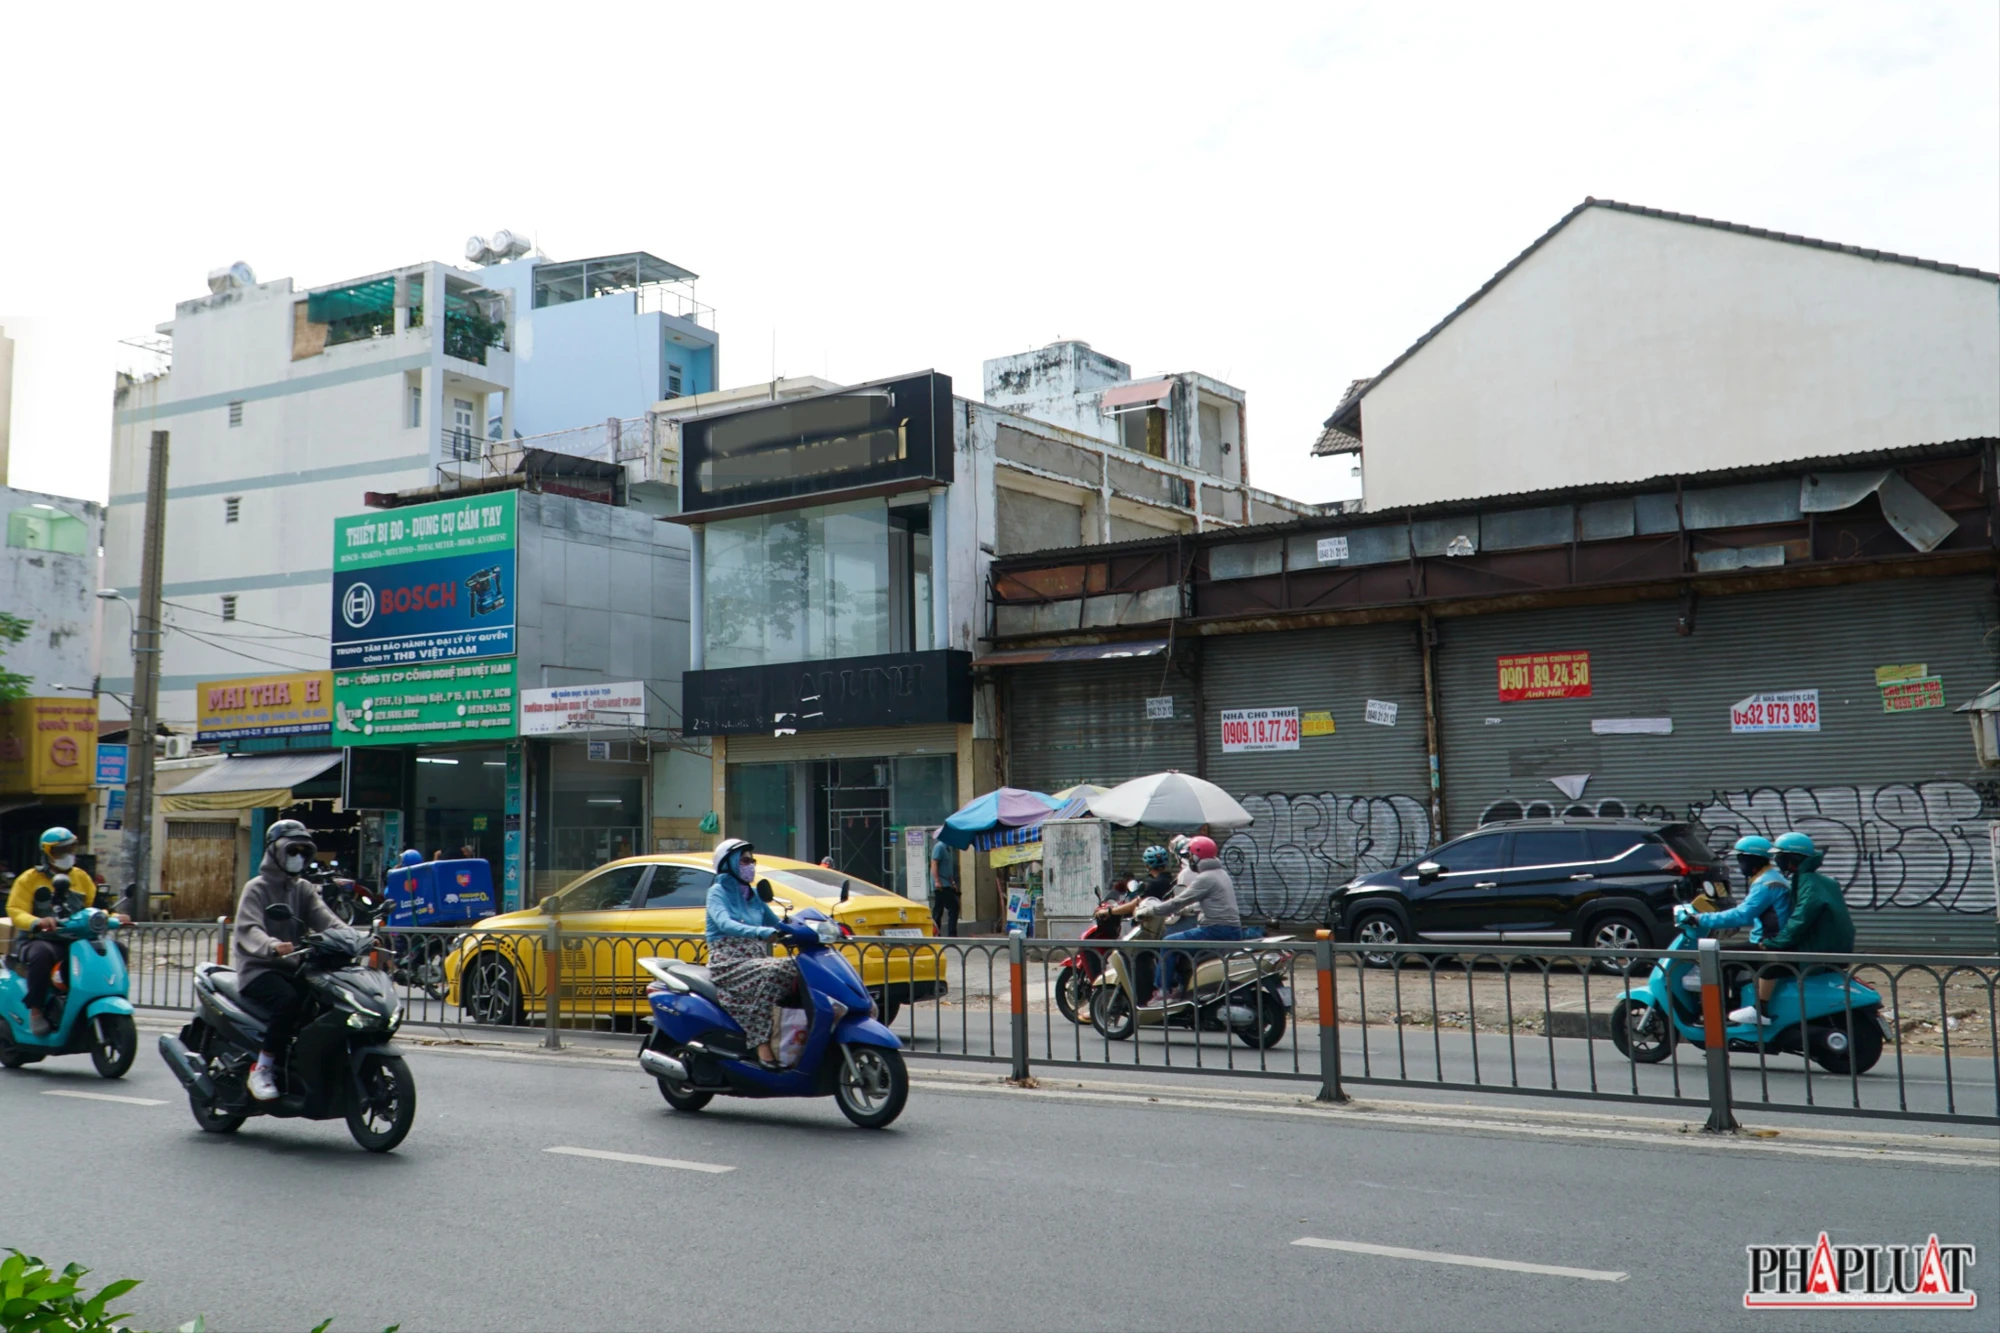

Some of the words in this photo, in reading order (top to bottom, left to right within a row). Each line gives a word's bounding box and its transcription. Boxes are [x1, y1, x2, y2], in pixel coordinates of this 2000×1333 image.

[346, 519, 376, 546] THIẾT
[378, 522, 389, 545] BỊ
[412, 514, 439, 540] DỤNG
[442, 512, 456, 536] CỤ
[482, 506, 502, 527] TAY
[380, 582, 456, 615] BOSCH
[336, 646, 362, 656] TRUNG
[364, 643, 382, 654] TÂM
[402, 638, 426, 649] HÀNH
[436, 636, 452, 646] ĐẠI
[363, 654, 382, 663] CÔNG
[393, 652, 416, 662] THB
[420, 647, 444, 660] VIỆT
[448, 645, 478, 656] NAM
[355, 672, 380, 685] CÔNG
[382, 673, 392, 683] TY
[392, 672, 404, 682] CP
[406, 668, 432, 681] CÔNG
[472, 662, 489, 678] VIỆT
[490, 664, 512, 674] NAM
[1500, 662, 1588, 690] 0901.89.24.50
[208, 686, 247, 712] MAI
[1223, 712, 1244, 720] NHÀ
[1248, 711, 1268, 720] CHO
[1272, 709, 1297, 718] THUÊ
[1767, 702, 1790, 724] 973
[1793, 702, 1816, 724] 983
[1223, 718, 1298, 744] 0909.19.77.29
